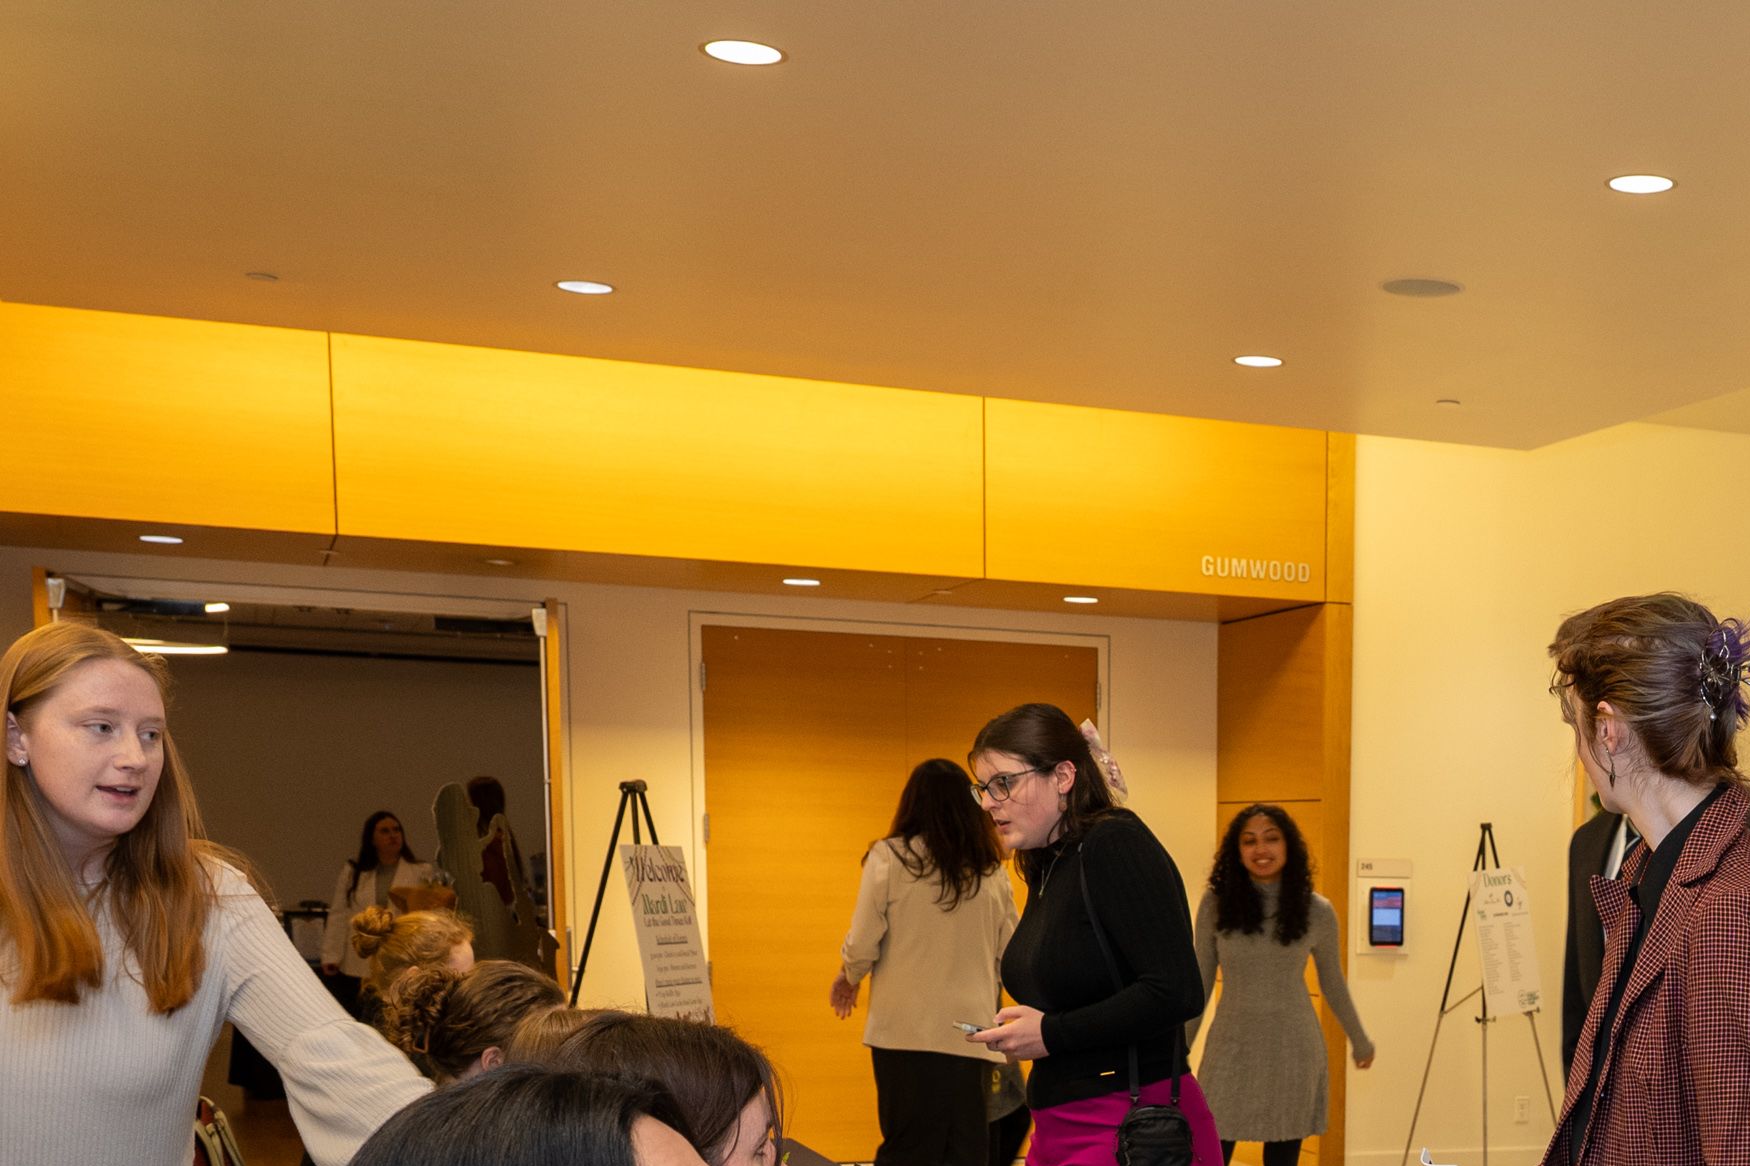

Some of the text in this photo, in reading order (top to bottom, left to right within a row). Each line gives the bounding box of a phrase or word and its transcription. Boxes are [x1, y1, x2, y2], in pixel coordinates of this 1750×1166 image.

[1201, 555, 1310, 582] GUMWOOD
[629, 856, 684, 882] Welcome
[1483, 873, 1512, 888] Donors
